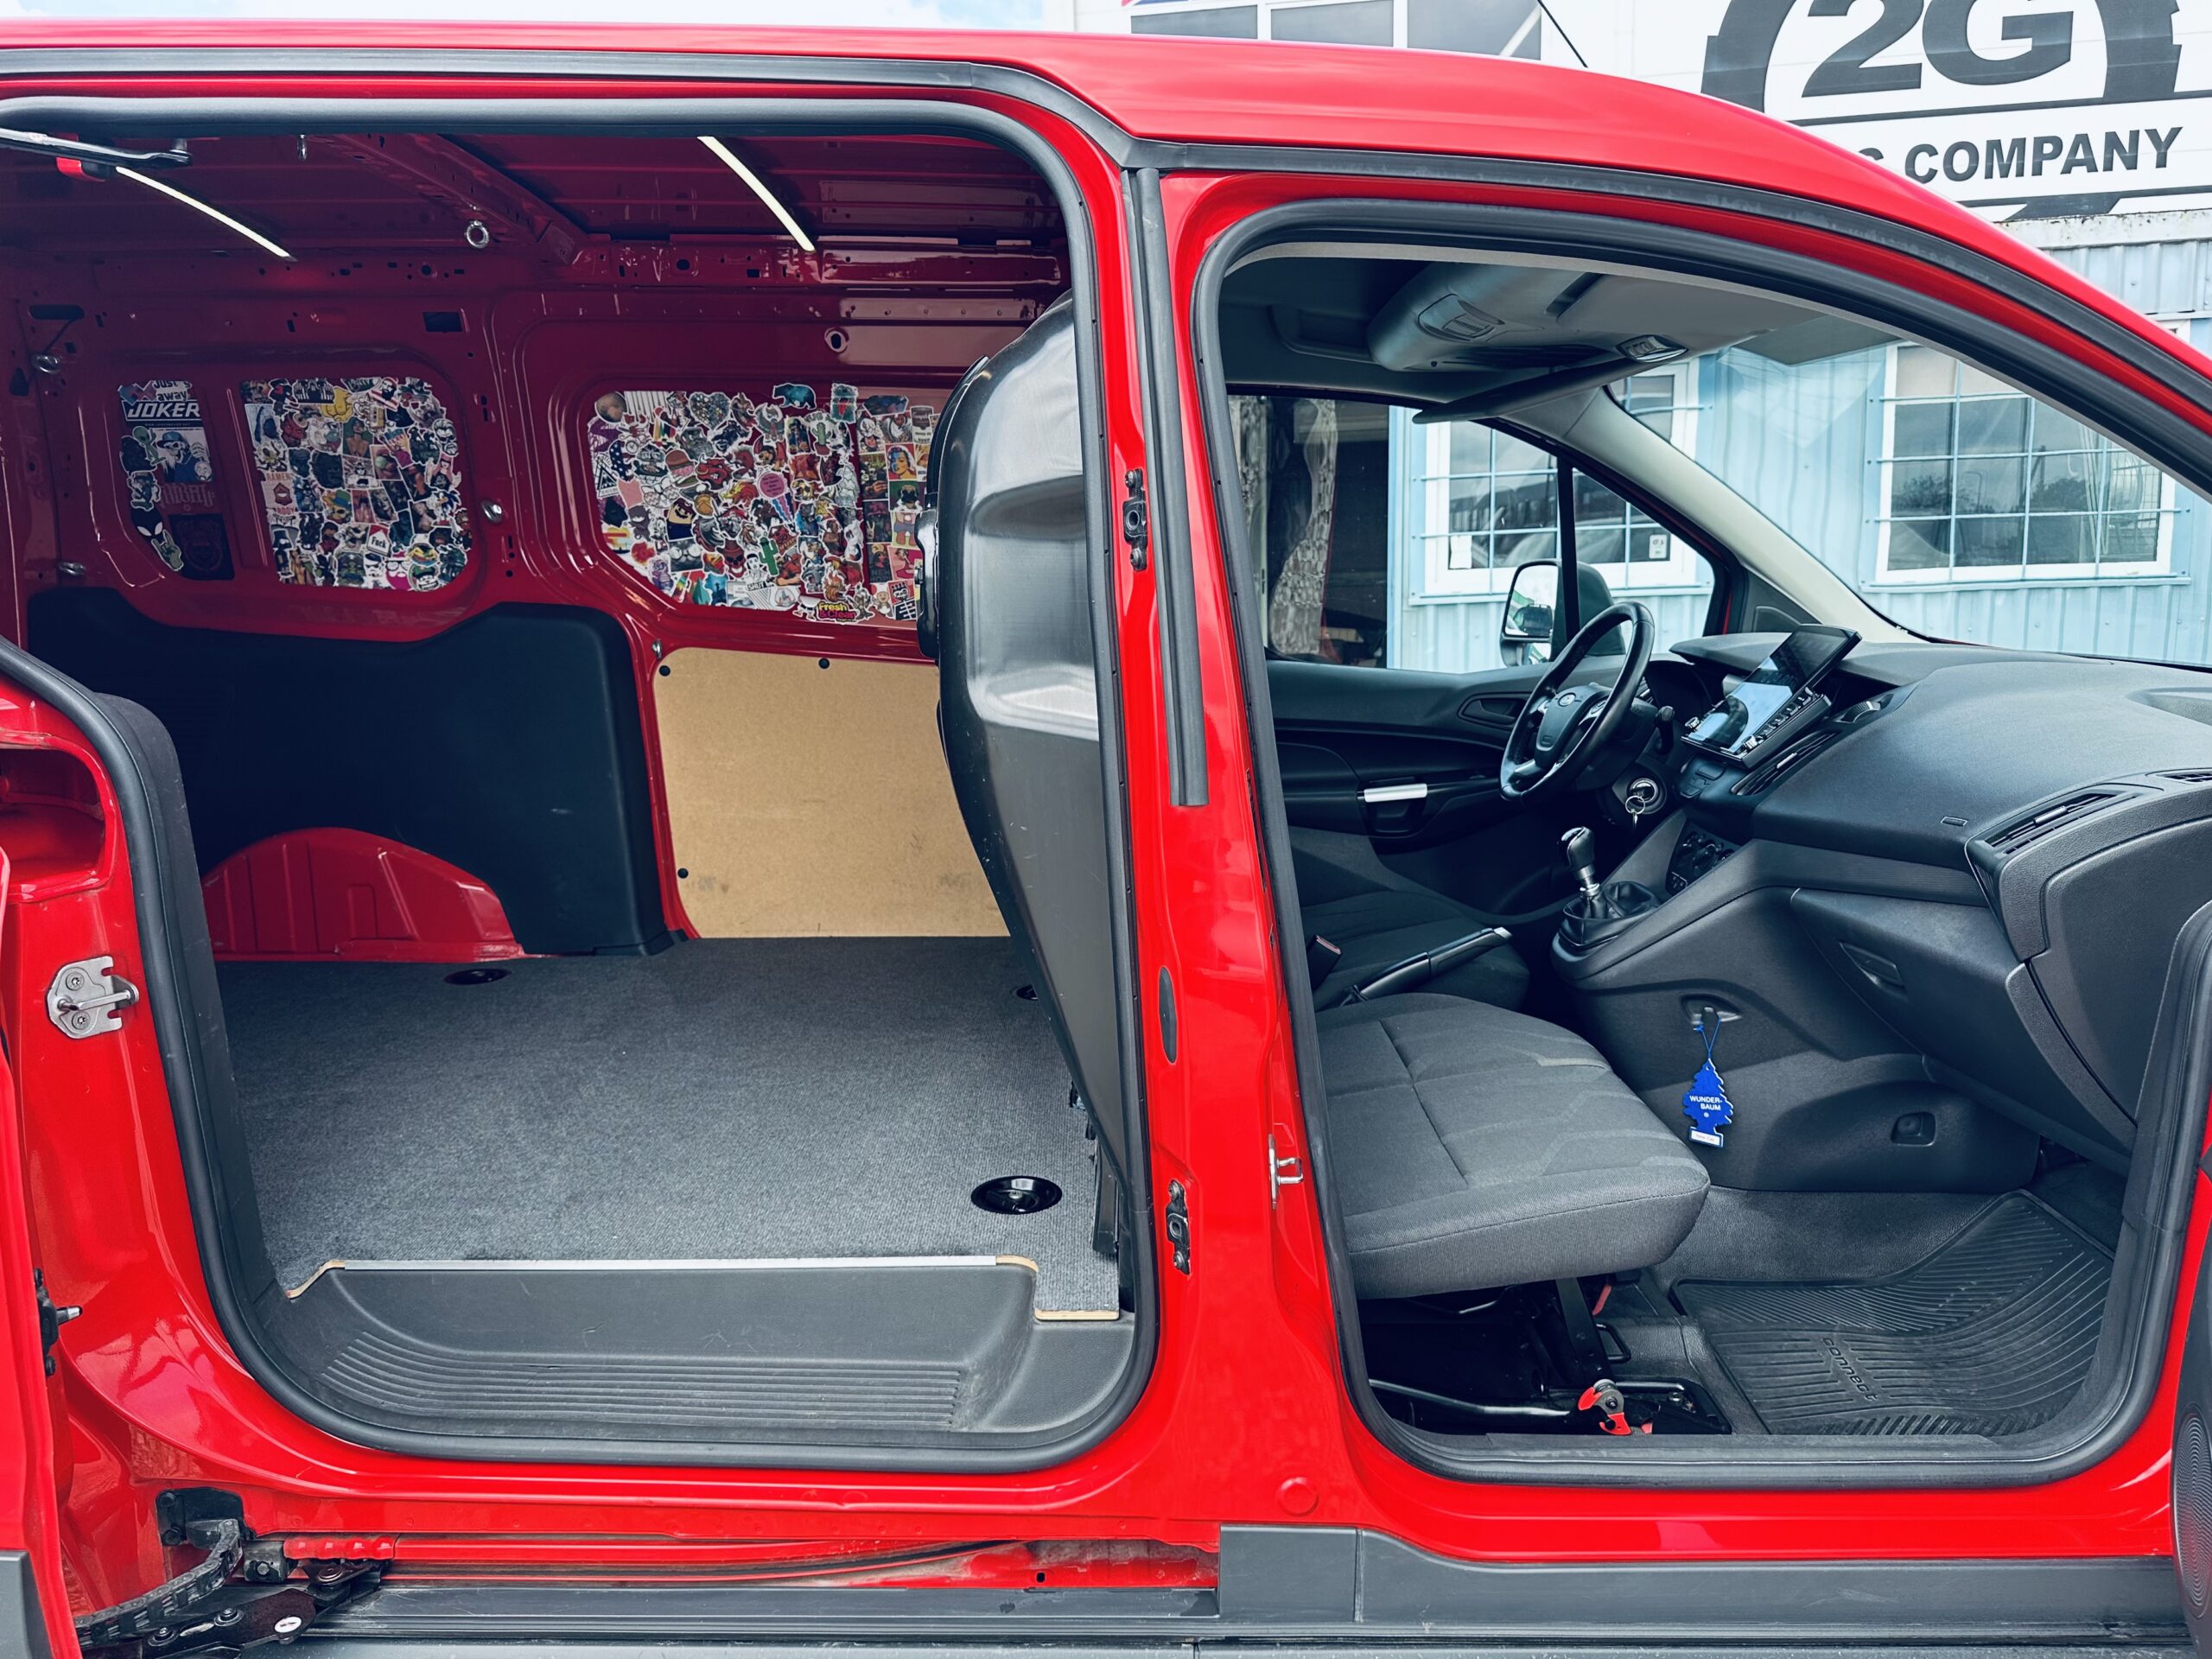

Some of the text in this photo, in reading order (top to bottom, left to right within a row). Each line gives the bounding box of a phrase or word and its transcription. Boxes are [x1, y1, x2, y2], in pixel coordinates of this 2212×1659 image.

[1802, 0, 2075, 98] 2G
[1904, 126, 2183, 185] COMPANY
[127, 402, 200, 418] JOKER
[819, 602, 848, 611] Fresh
[1689, 1095, 1723, 1103] WUNDER-
[1700, 1103, 1721, 1111] BAUM
[1821, 1337, 1878, 1402] connect
